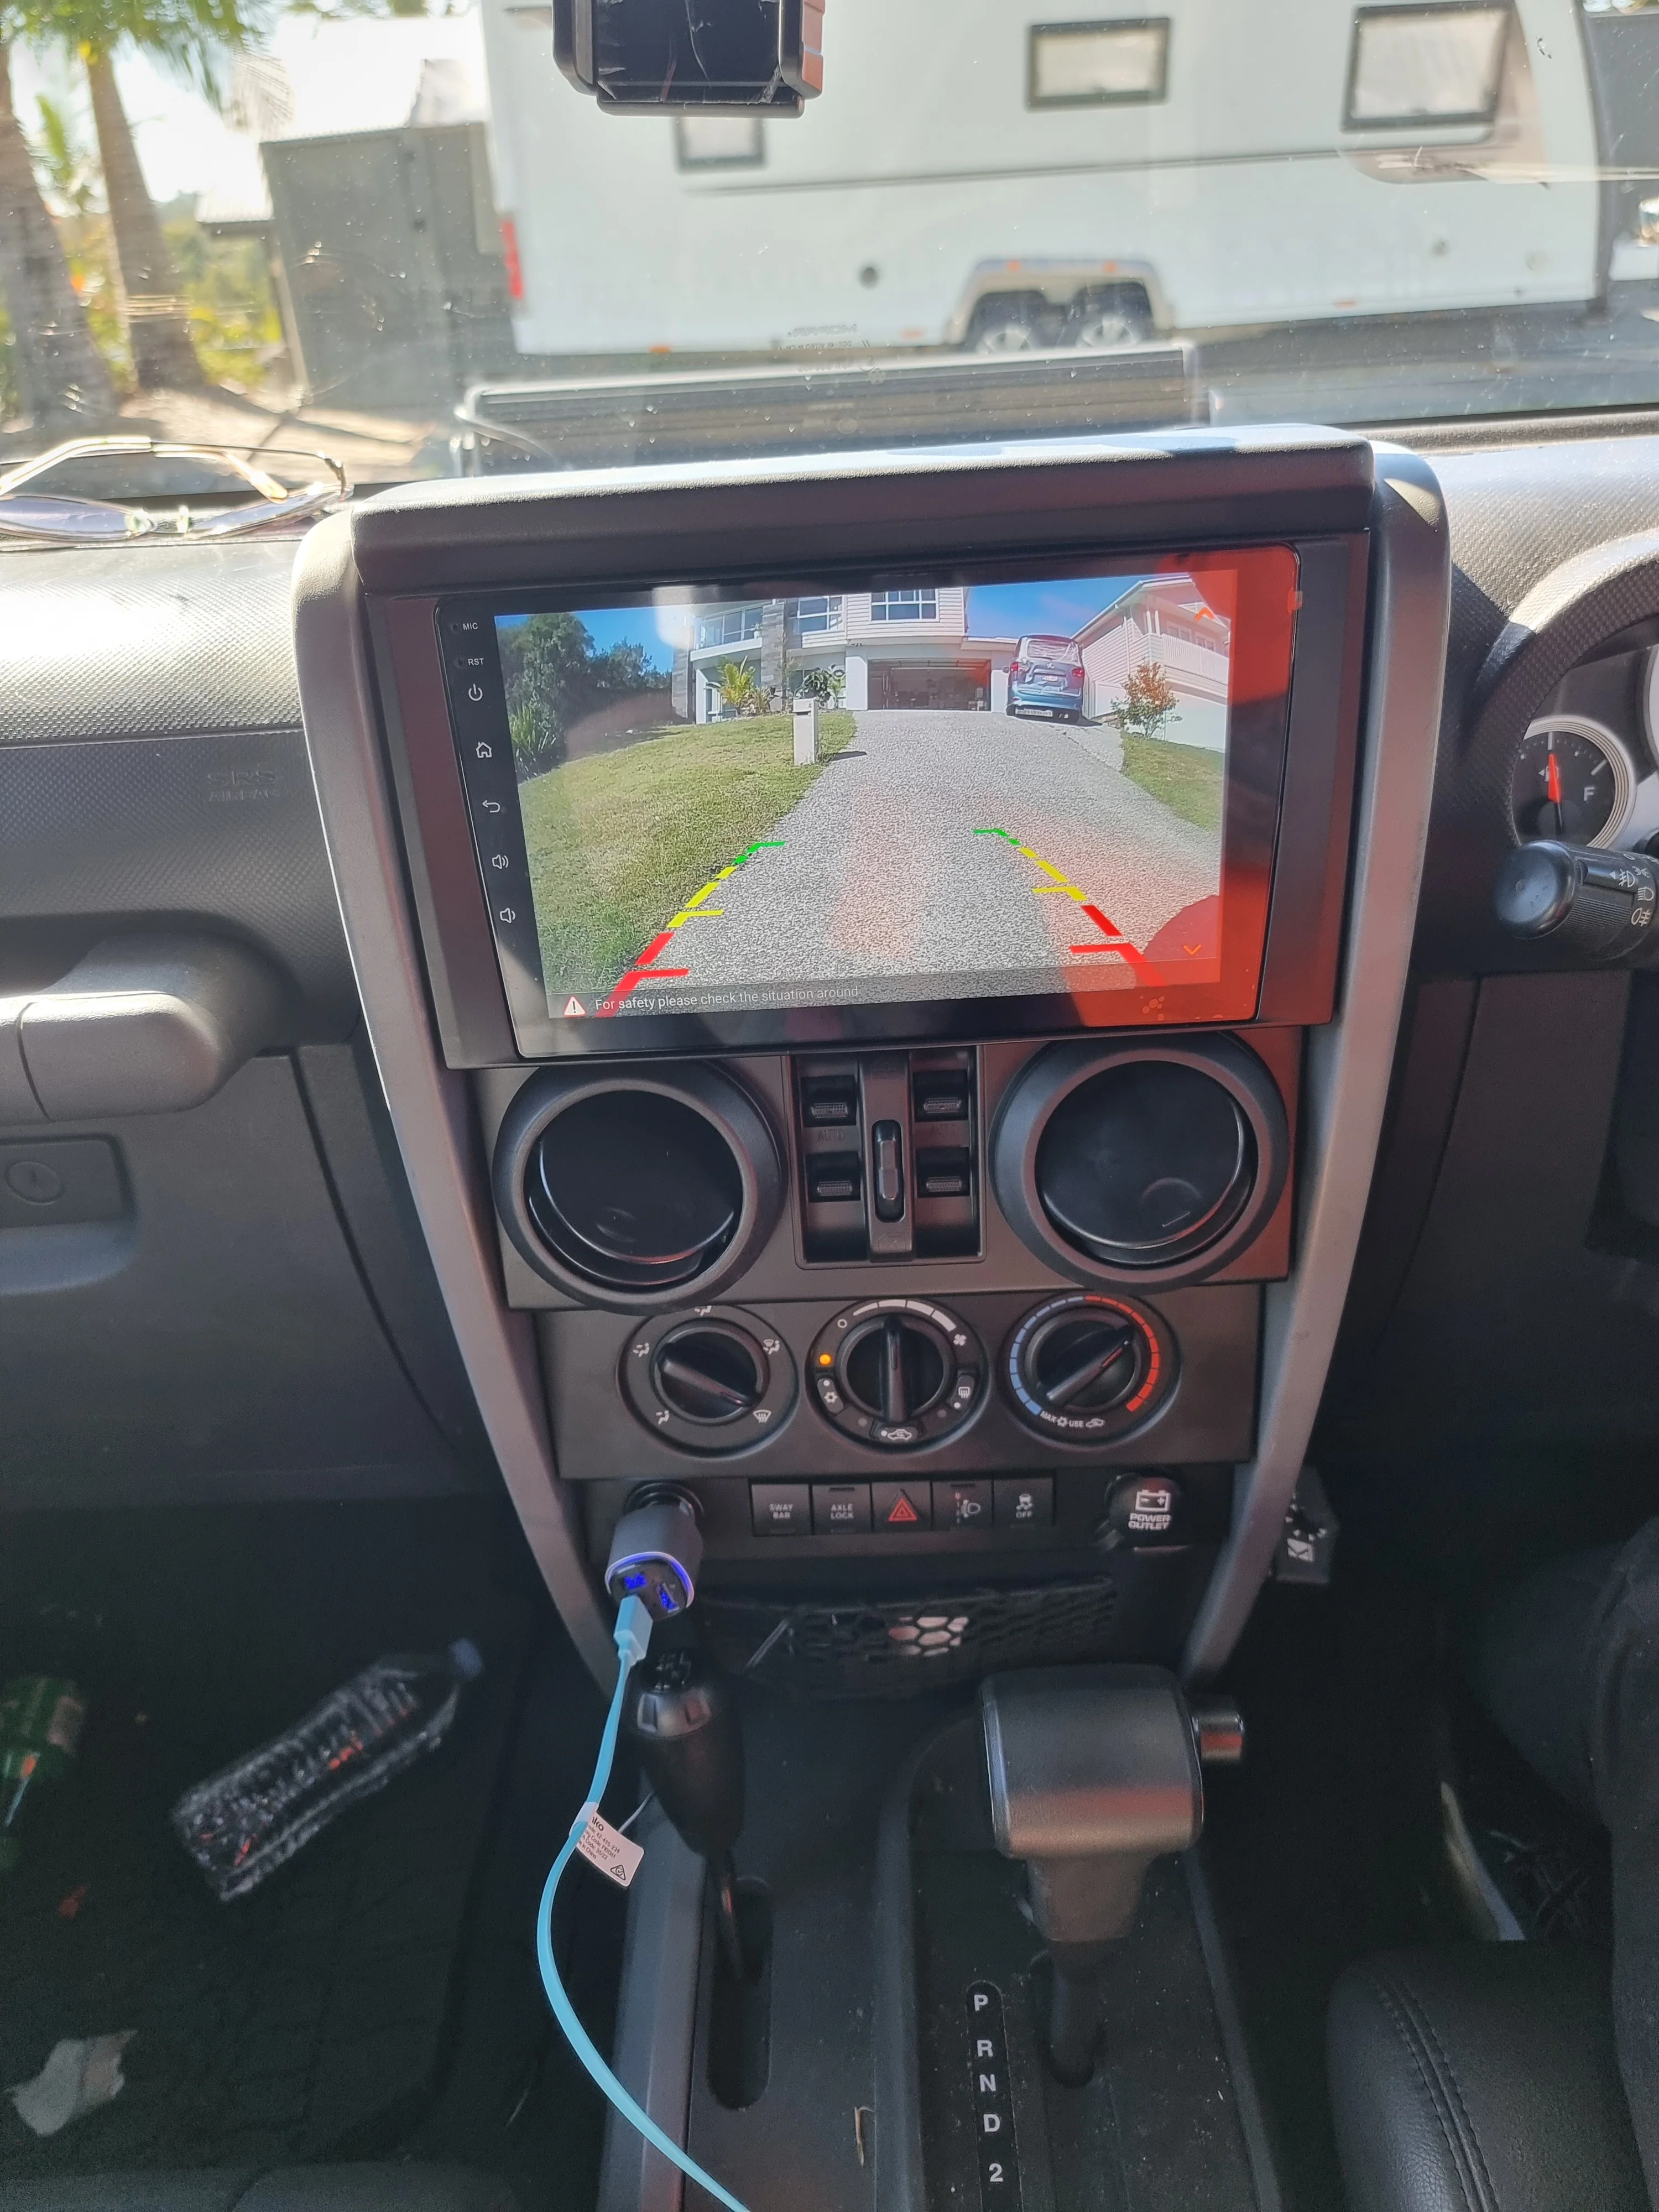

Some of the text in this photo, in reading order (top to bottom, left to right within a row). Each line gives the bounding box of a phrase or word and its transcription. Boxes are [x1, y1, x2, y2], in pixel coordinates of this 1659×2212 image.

[1583, 786, 1595, 801] F
[595, 986, 858, 1010] For safety please check the situation around
[1040, 1410, 1084, 1428] MAX USE
[1128, 1521, 1169, 1531] OUTLET
[1130, 1512, 1171, 1522] POWER
[973, 1994, 989, 2011] P
[977, 2039, 994, 2058] R
[979, 2074, 997, 2093] N
[983, 2114, 1000, 2132] D
[988, 2163, 1004, 2182] 2
